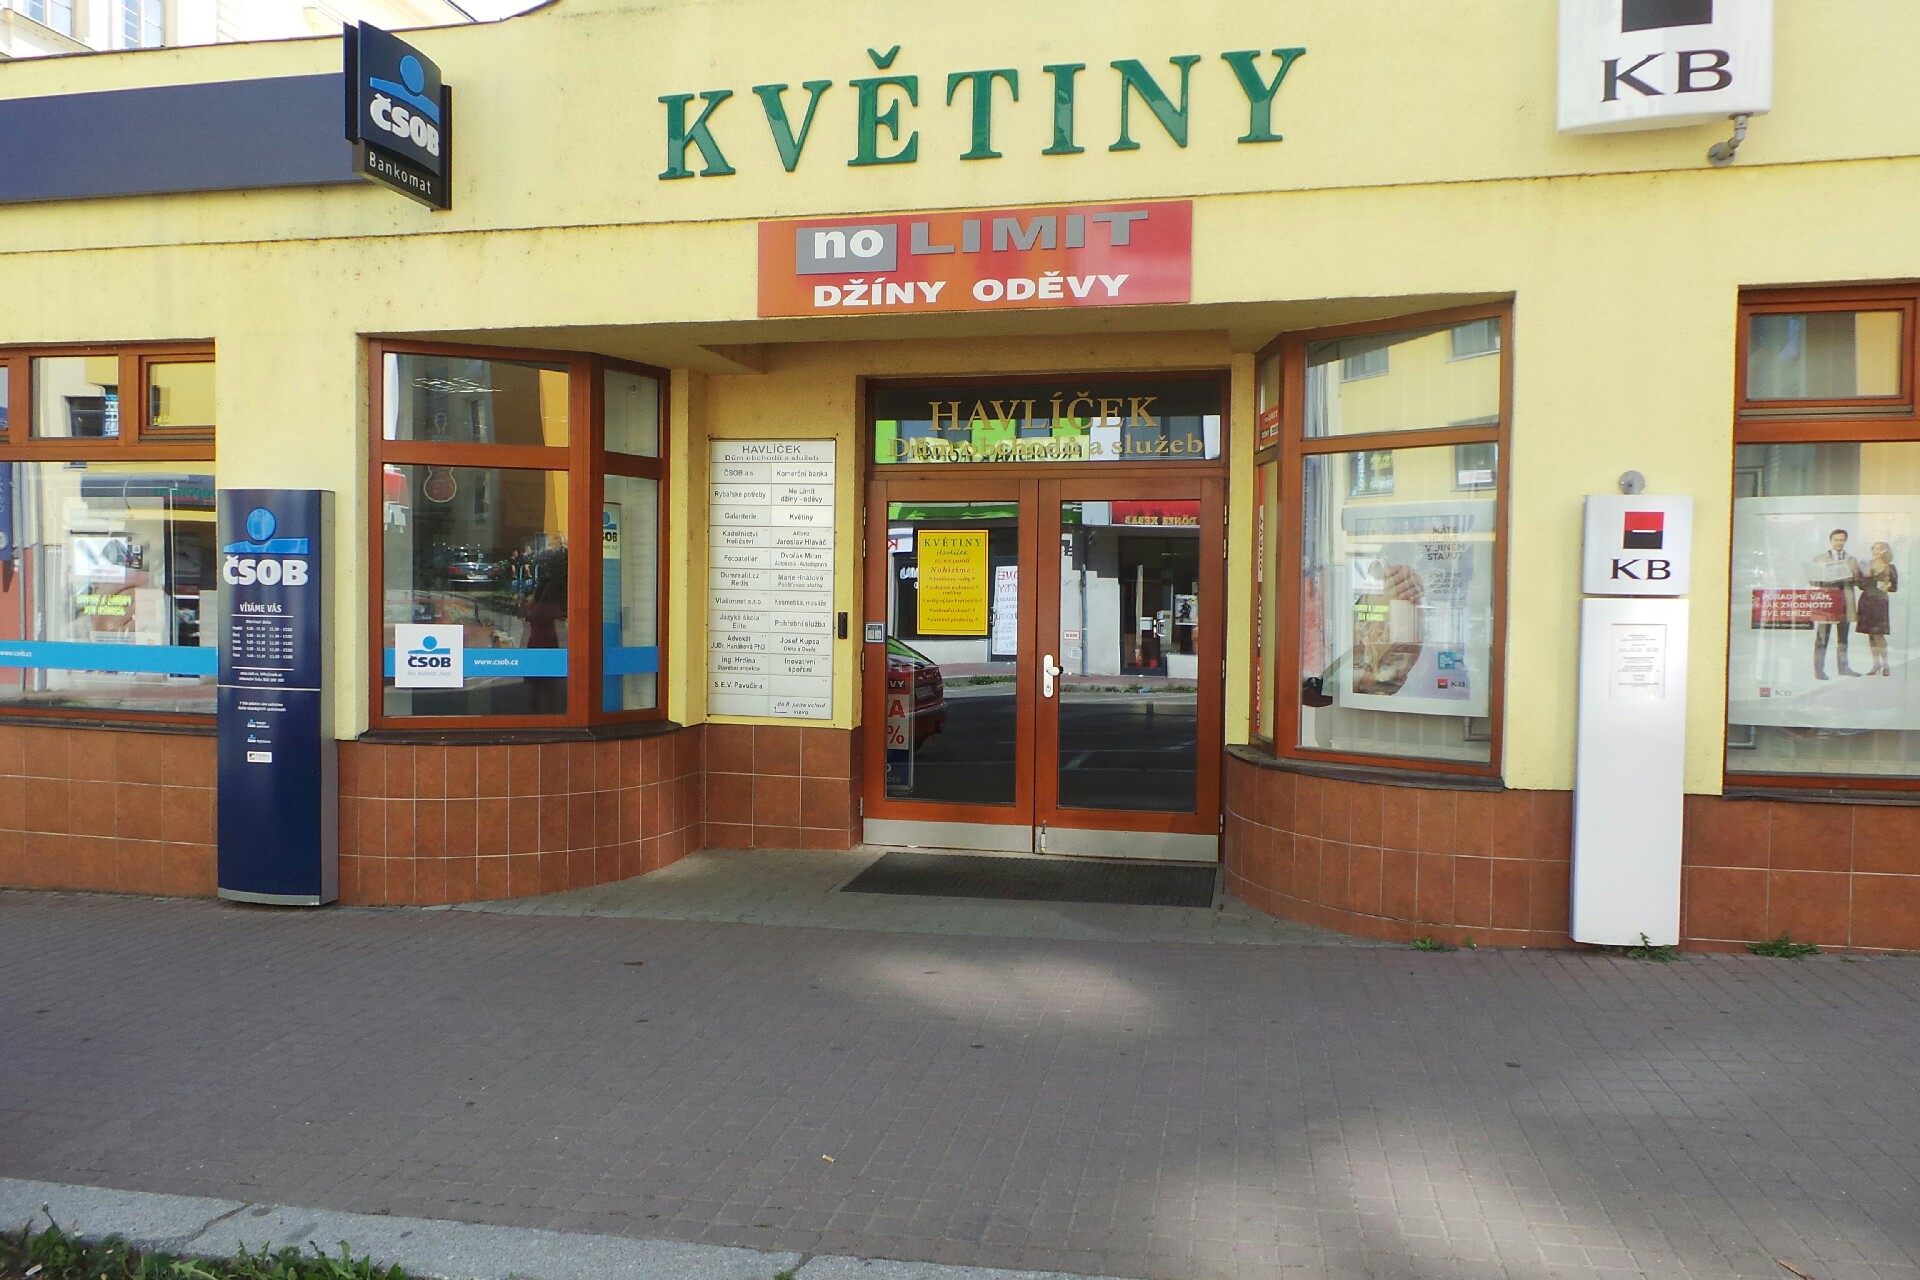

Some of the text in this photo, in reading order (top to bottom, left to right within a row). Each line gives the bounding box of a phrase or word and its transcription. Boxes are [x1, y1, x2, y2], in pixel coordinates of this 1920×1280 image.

[1599, 49, 1733, 102] KB
[370, 92, 440, 158] ČSOB
[658, 45, 1306, 180] KVĚTINY
[369, 152, 432, 195] Bankomat
[814, 210, 1148, 259] no LIMIT
[814, 271, 1129, 308] DŽÍNY ODĚVY
[929, 391, 1158, 430] HAVLÍČEK
[743, 443, 801, 453] HAVLÍČEK
[1090, 442, 1104, 456] a
[1112, 433, 1204, 455] služeb
[790, 513, 813, 521] Květiny
[223, 555, 308, 586] ČSOB
[1610, 559, 1671, 580] KB
[240, 602, 282, 613] VÍTÁME VÁS
[408, 655, 451, 668] ČSOB
